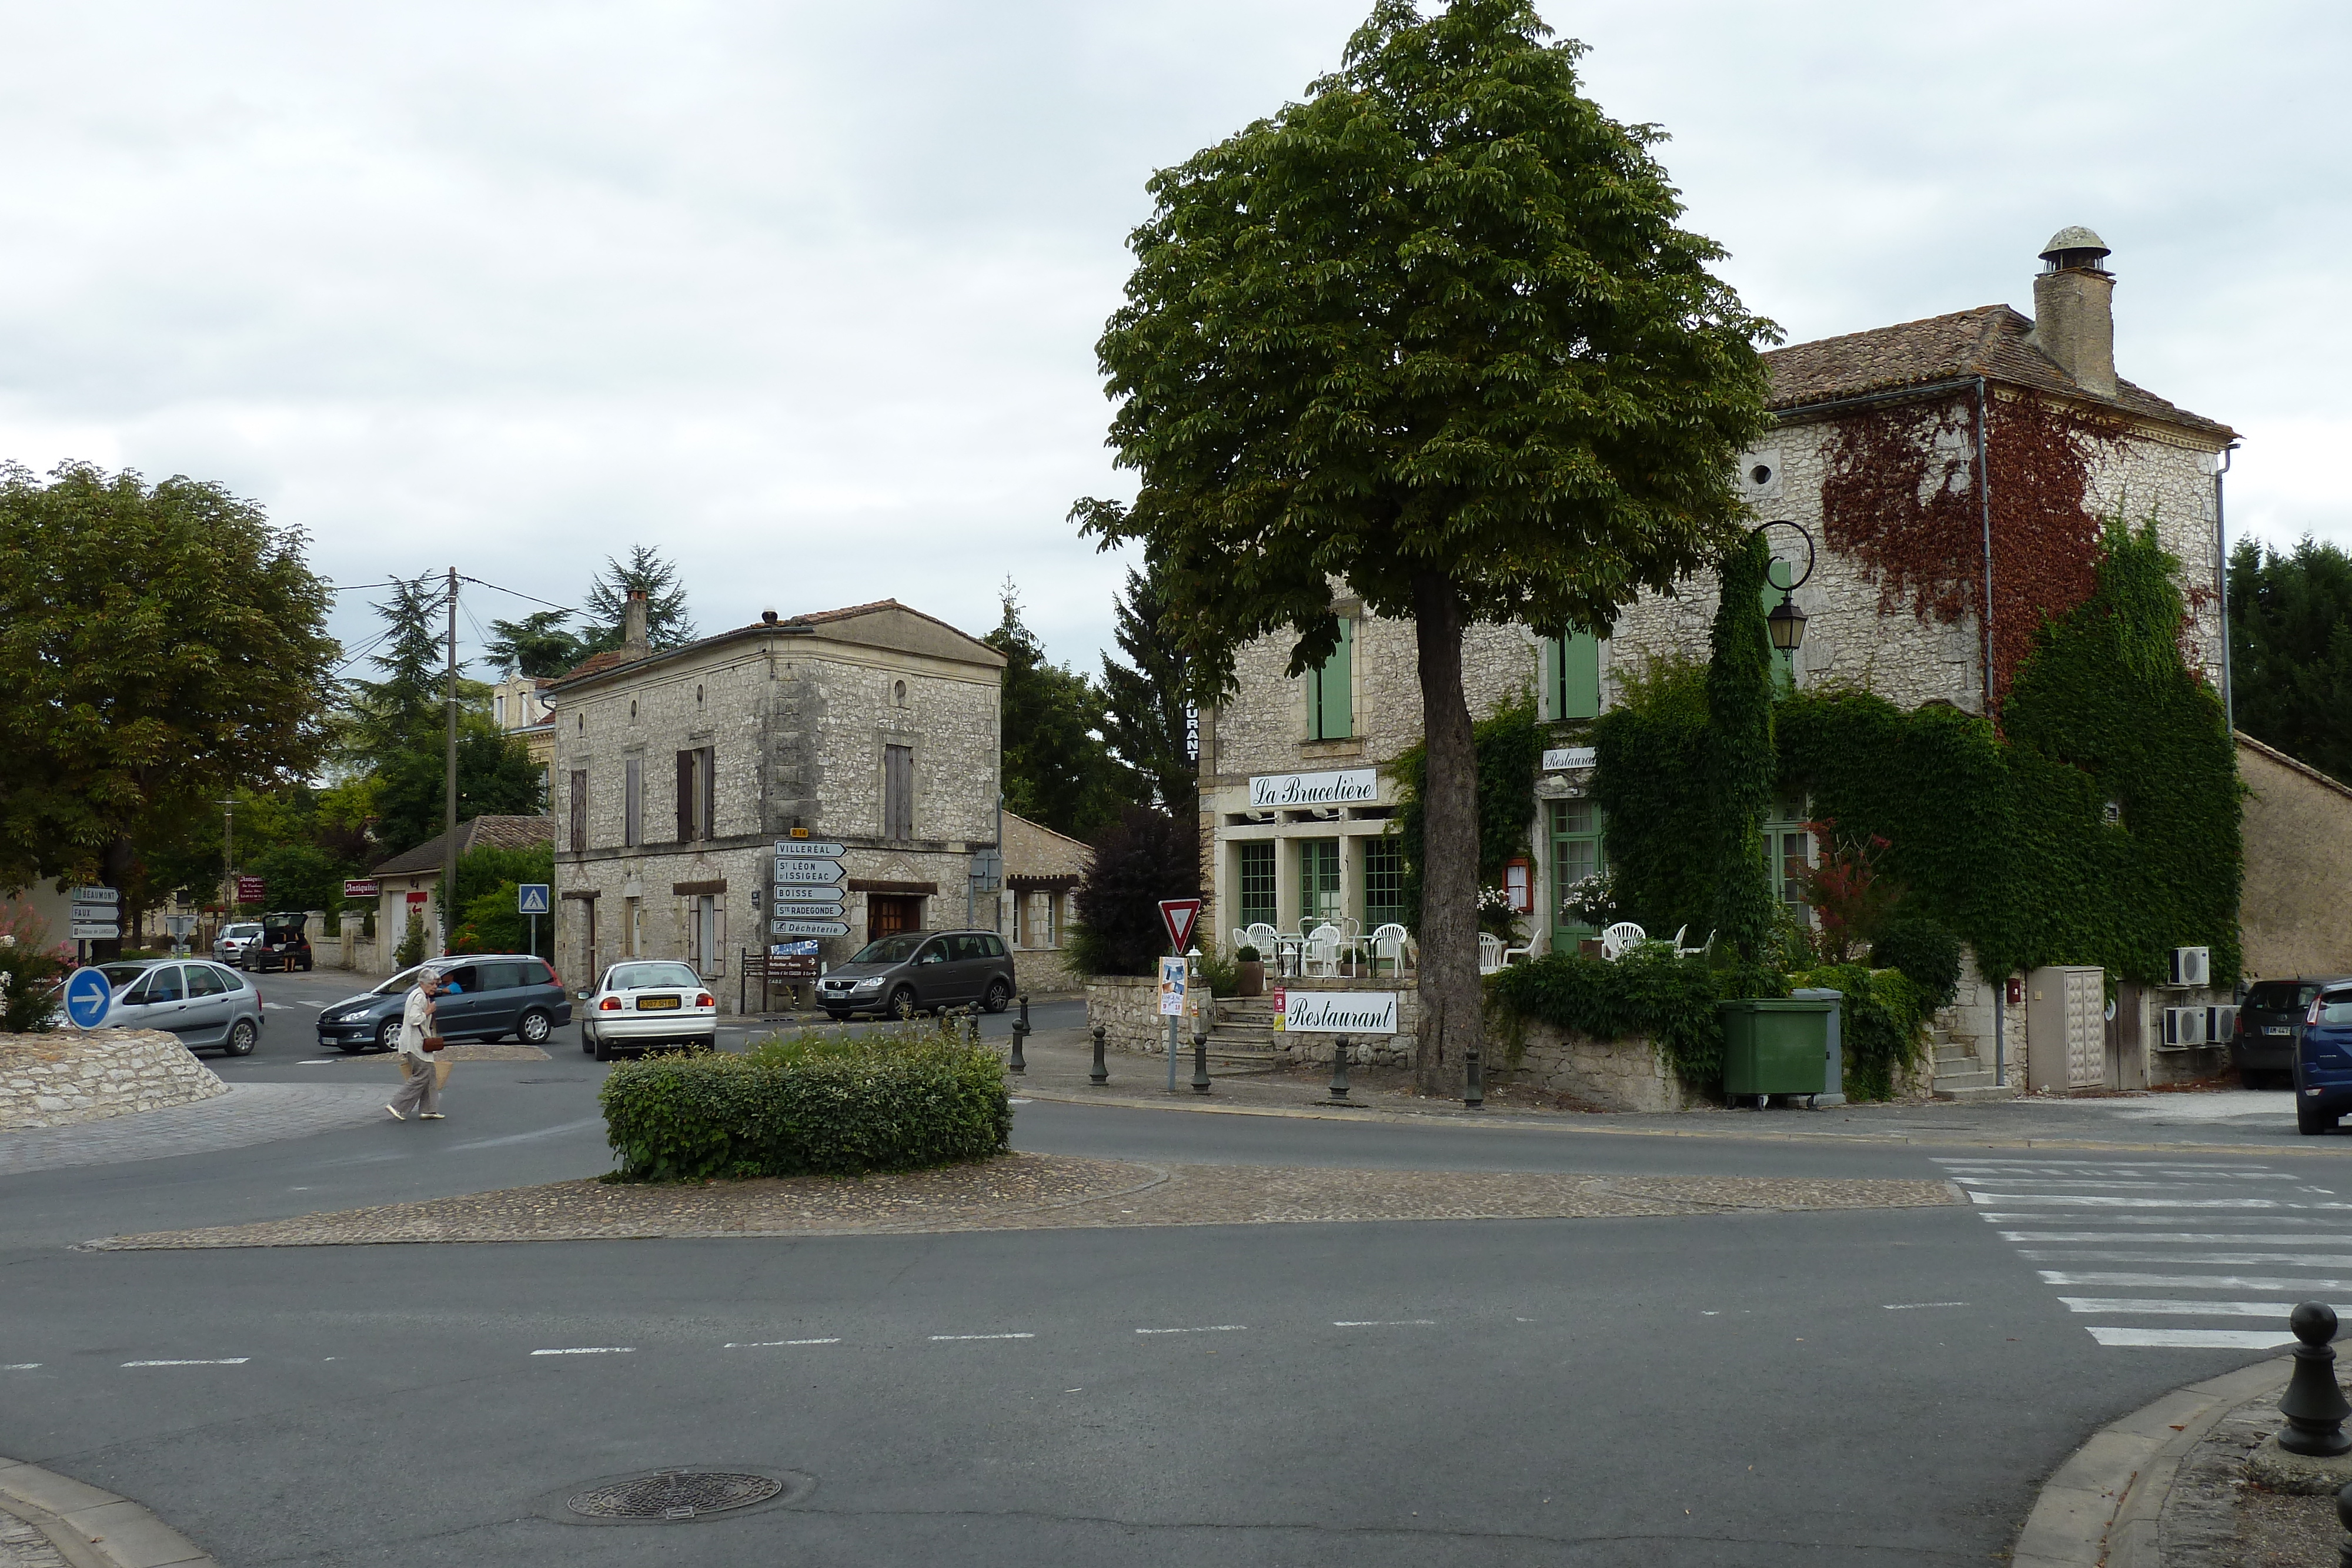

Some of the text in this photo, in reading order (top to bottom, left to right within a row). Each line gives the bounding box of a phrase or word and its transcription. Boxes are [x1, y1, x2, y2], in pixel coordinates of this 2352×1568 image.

[1253, 775, 1374, 804] La Brucelière
[780, 844, 830, 854] VILLERÉAL
[793, 861, 816, 871] LÉON
[82, 890, 115, 900] BEAUMONT
[779, 889, 813, 897] BOISSE
[791, 907, 834, 915] RADEGONDE
[789, 924, 838, 933] Déchèterie
[1288, 997, 1393, 1027] Restaurant
